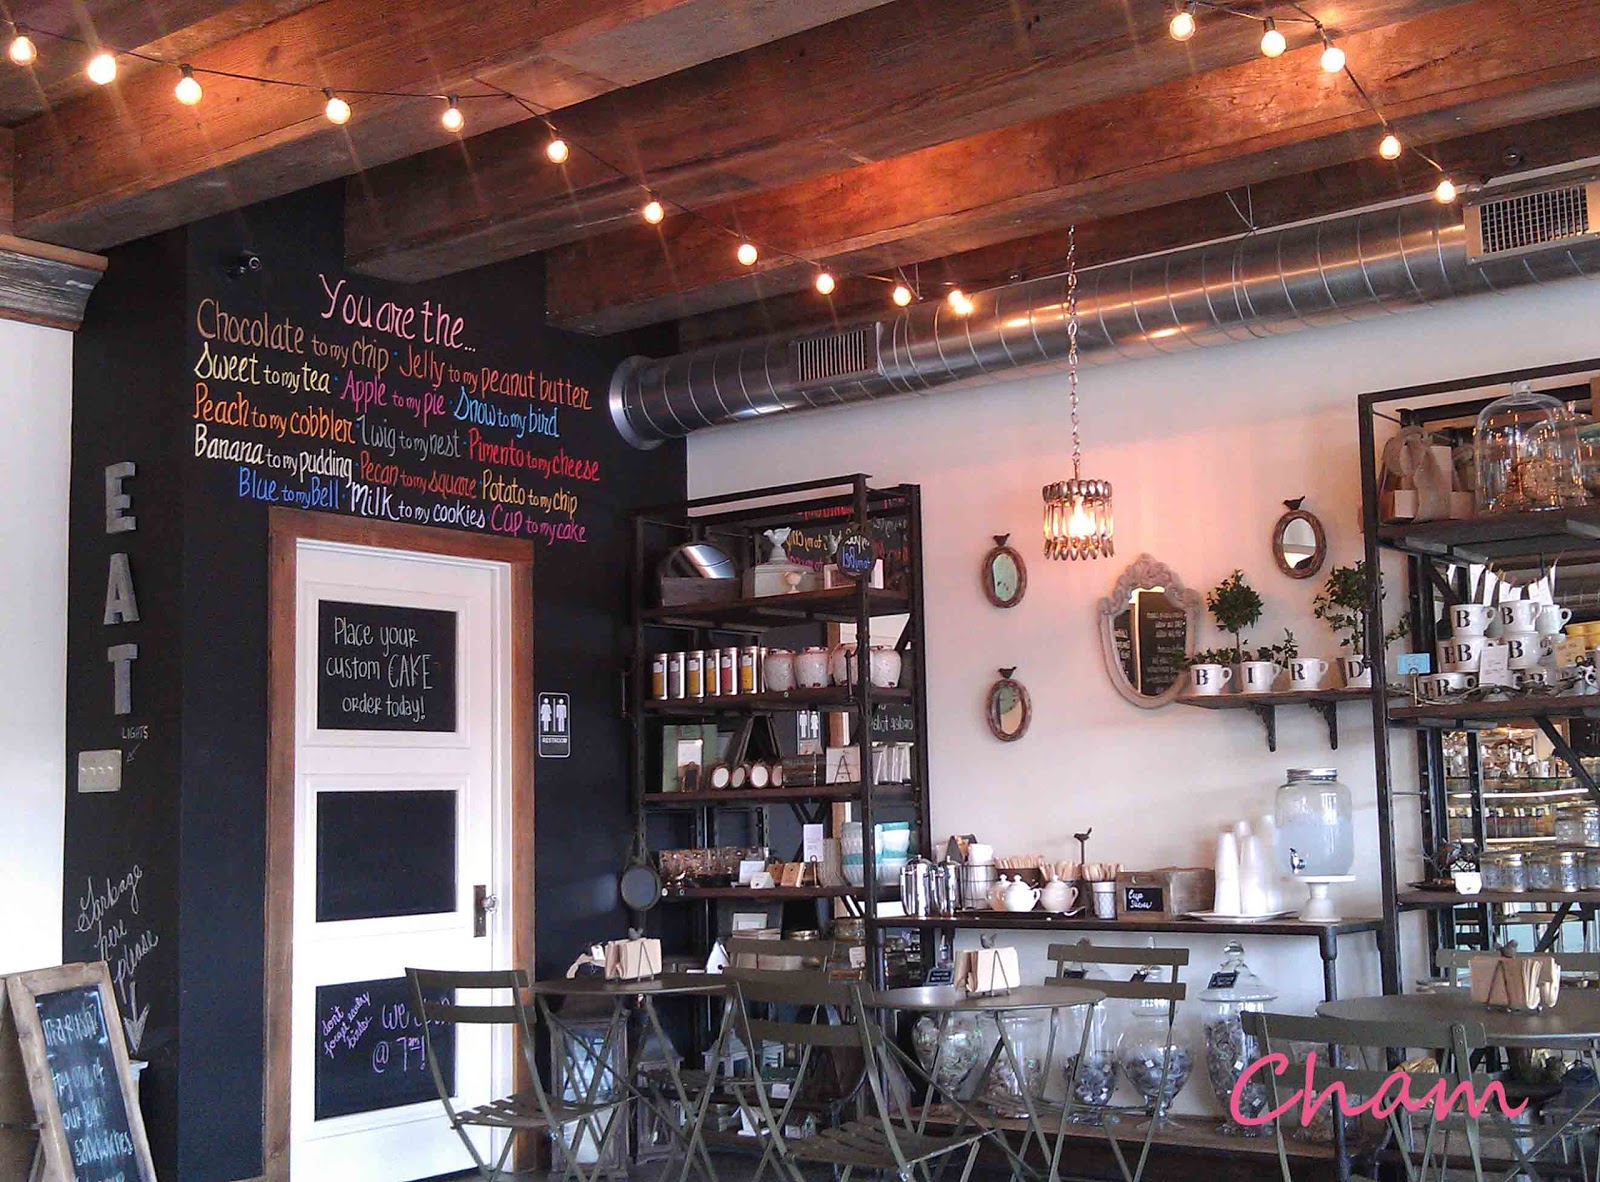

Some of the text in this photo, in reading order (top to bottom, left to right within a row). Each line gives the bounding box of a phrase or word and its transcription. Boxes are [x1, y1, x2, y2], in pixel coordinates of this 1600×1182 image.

[319, 273, 372, 327] You
[376, 302, 416, 340] are
[196, 298, 593, 411] Chocolate to my chip Jelly to my peanut butter
[194, 341, 560, 438] Sweet to my tea Apple to my pie Snow to my bird
[193, 382, 600, 482] Peach to my cobbler Twig to my nest Pimento to my cheese
[195, 424, 578, 520] Banana to my pudding Pecan to my square Potato to my chip
[238, 466, 587, 546] Blue to my Bell Milk to my cookies Cup to my cake
[103, 461, 140, 715] EAT
[334, 616, 419, 658] Place your
[1456, 609, 1471, 628] B
[325, 653, 434, 690] custom CAKE
[1458, 643, 1473, 662] B
[1508, 640, 1523, 659] B
[121, 725, 149, 740] LIGHTS
[342, 693, 426, 723] order today!
[75, 864, 143, 933] Garbage
[94, 919, 127, 961] here
[114, 930, 159, 1004] please
[373, 1041, 389, 1074] @
